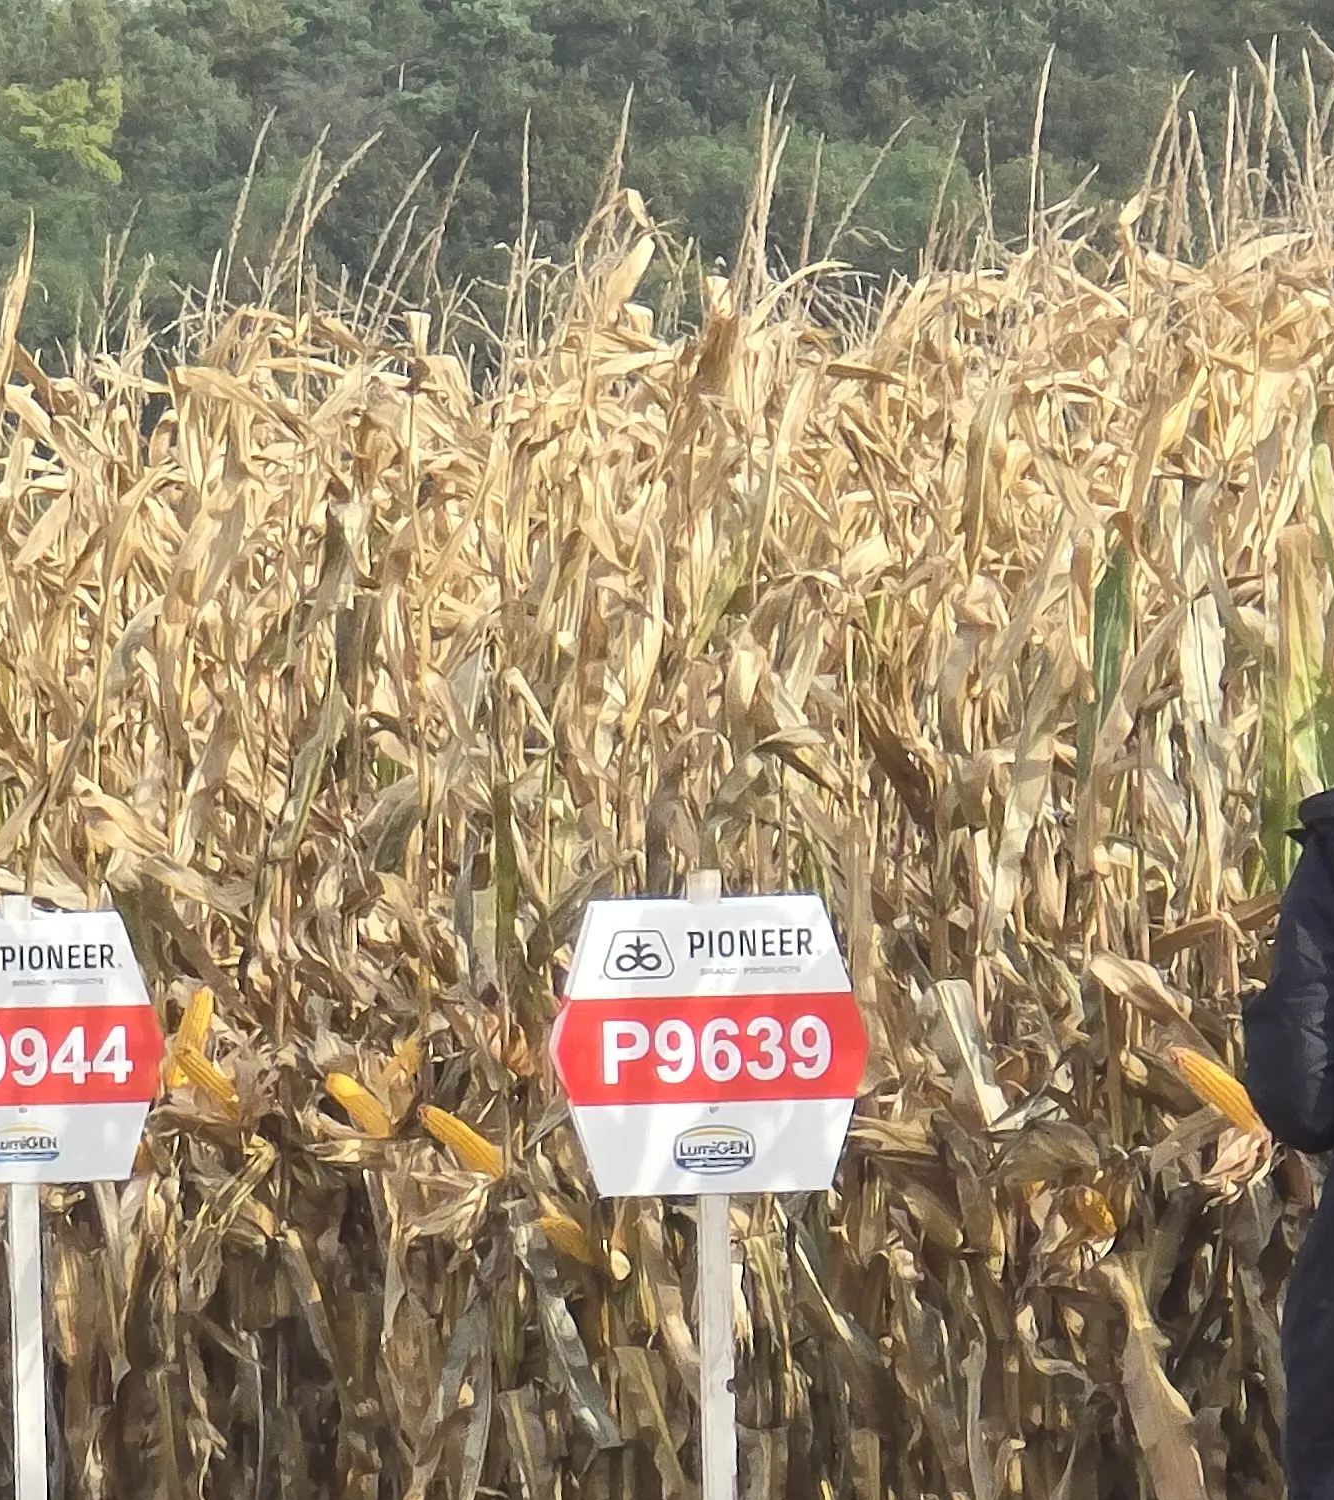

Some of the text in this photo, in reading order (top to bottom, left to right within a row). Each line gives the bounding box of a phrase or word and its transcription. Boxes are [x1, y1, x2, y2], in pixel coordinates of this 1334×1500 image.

[0, 944, 115, 971] PIONEER
[686, 928, 813, 958] PIONEER
[602, 1015, 832, 1085] P9639
